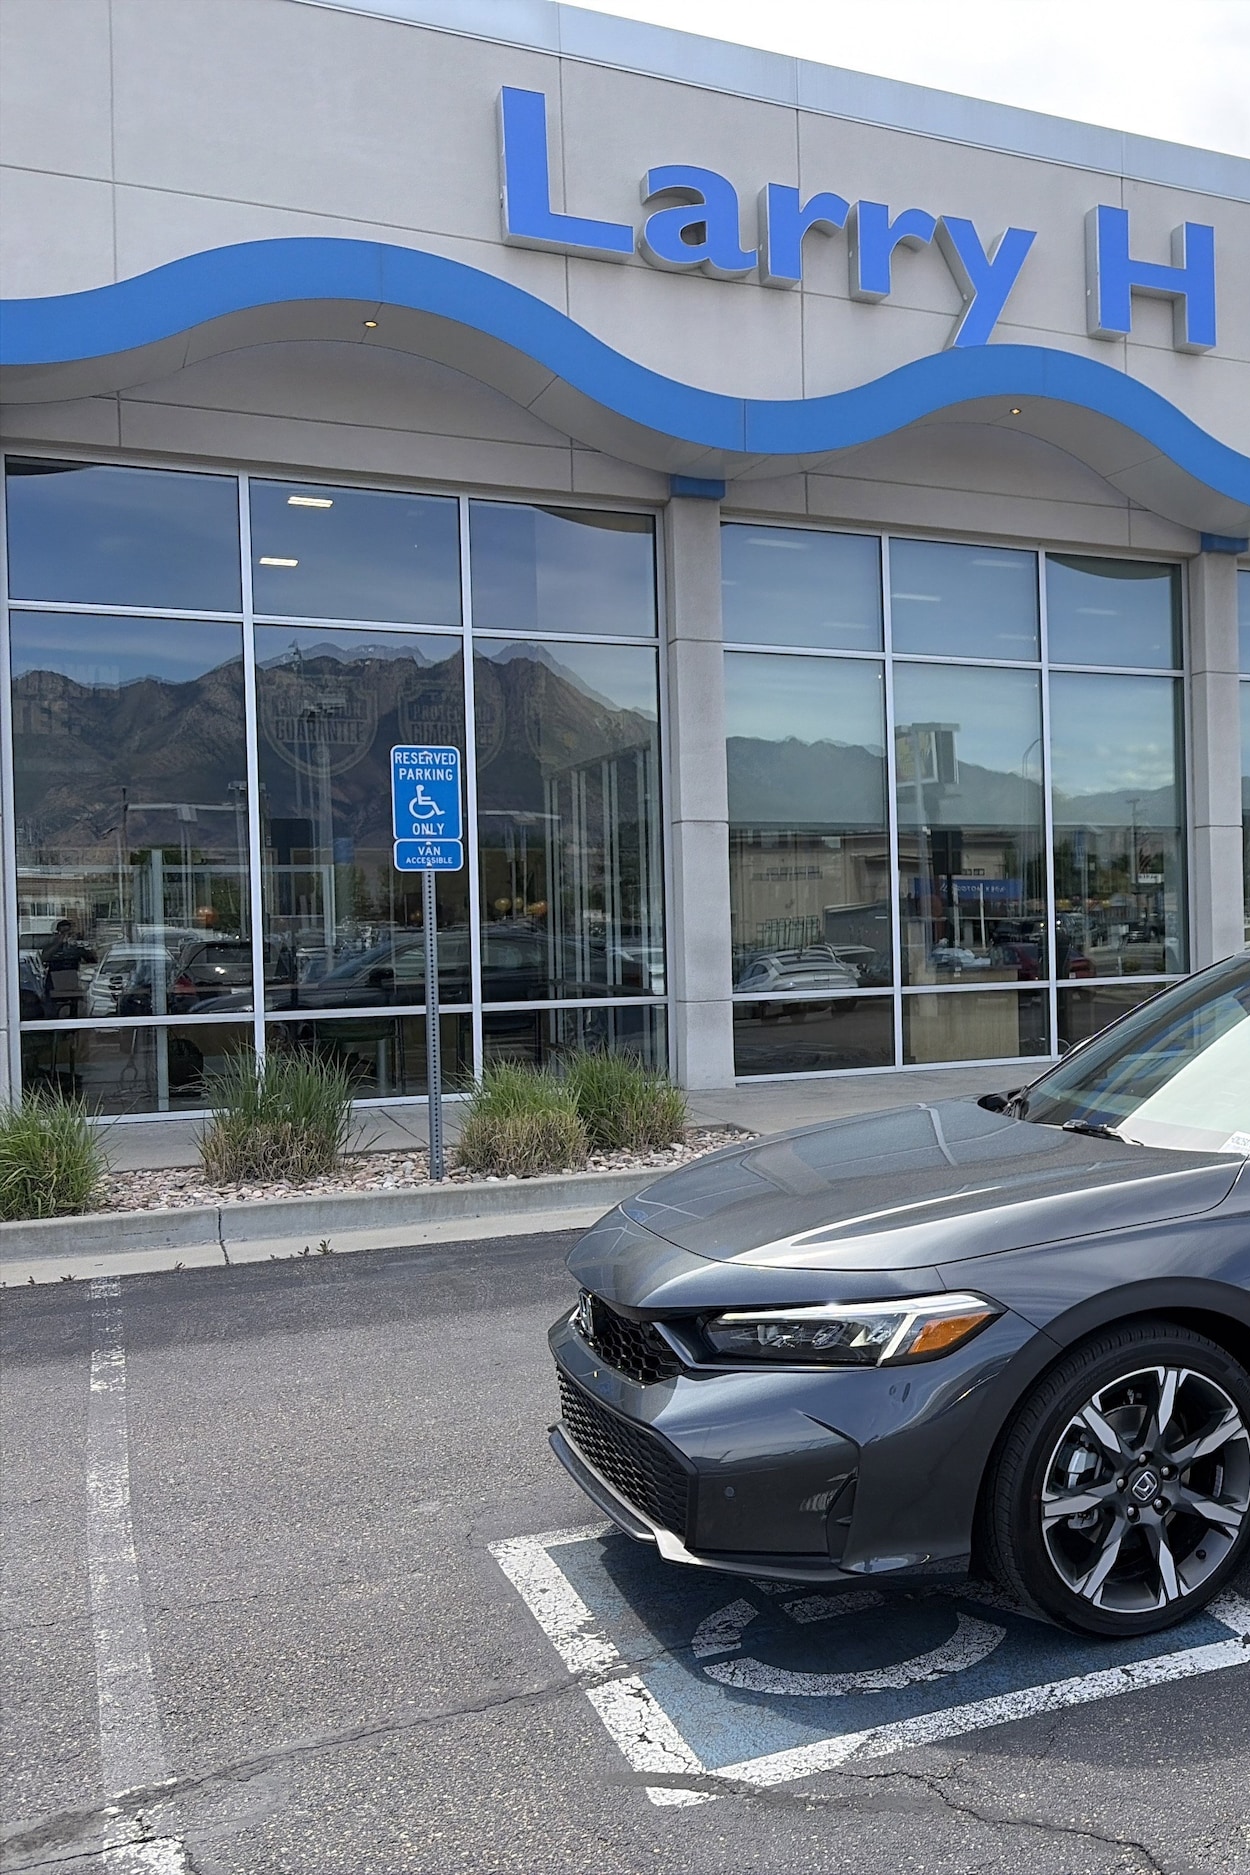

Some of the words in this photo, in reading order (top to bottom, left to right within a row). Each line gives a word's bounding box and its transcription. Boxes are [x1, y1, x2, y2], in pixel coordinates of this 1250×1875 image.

[499, 85, 1038, 351] Larry
[1085, 203, 1217, 355] H
[394, 751, 456, 765] RESERVED
[399, 767, 453, 781] PARKING
[412, 822, 445, 836] ONLY
[417, 846, 441, 856] VAN
[405, 856, 453, 864] ACCESSIBLE
